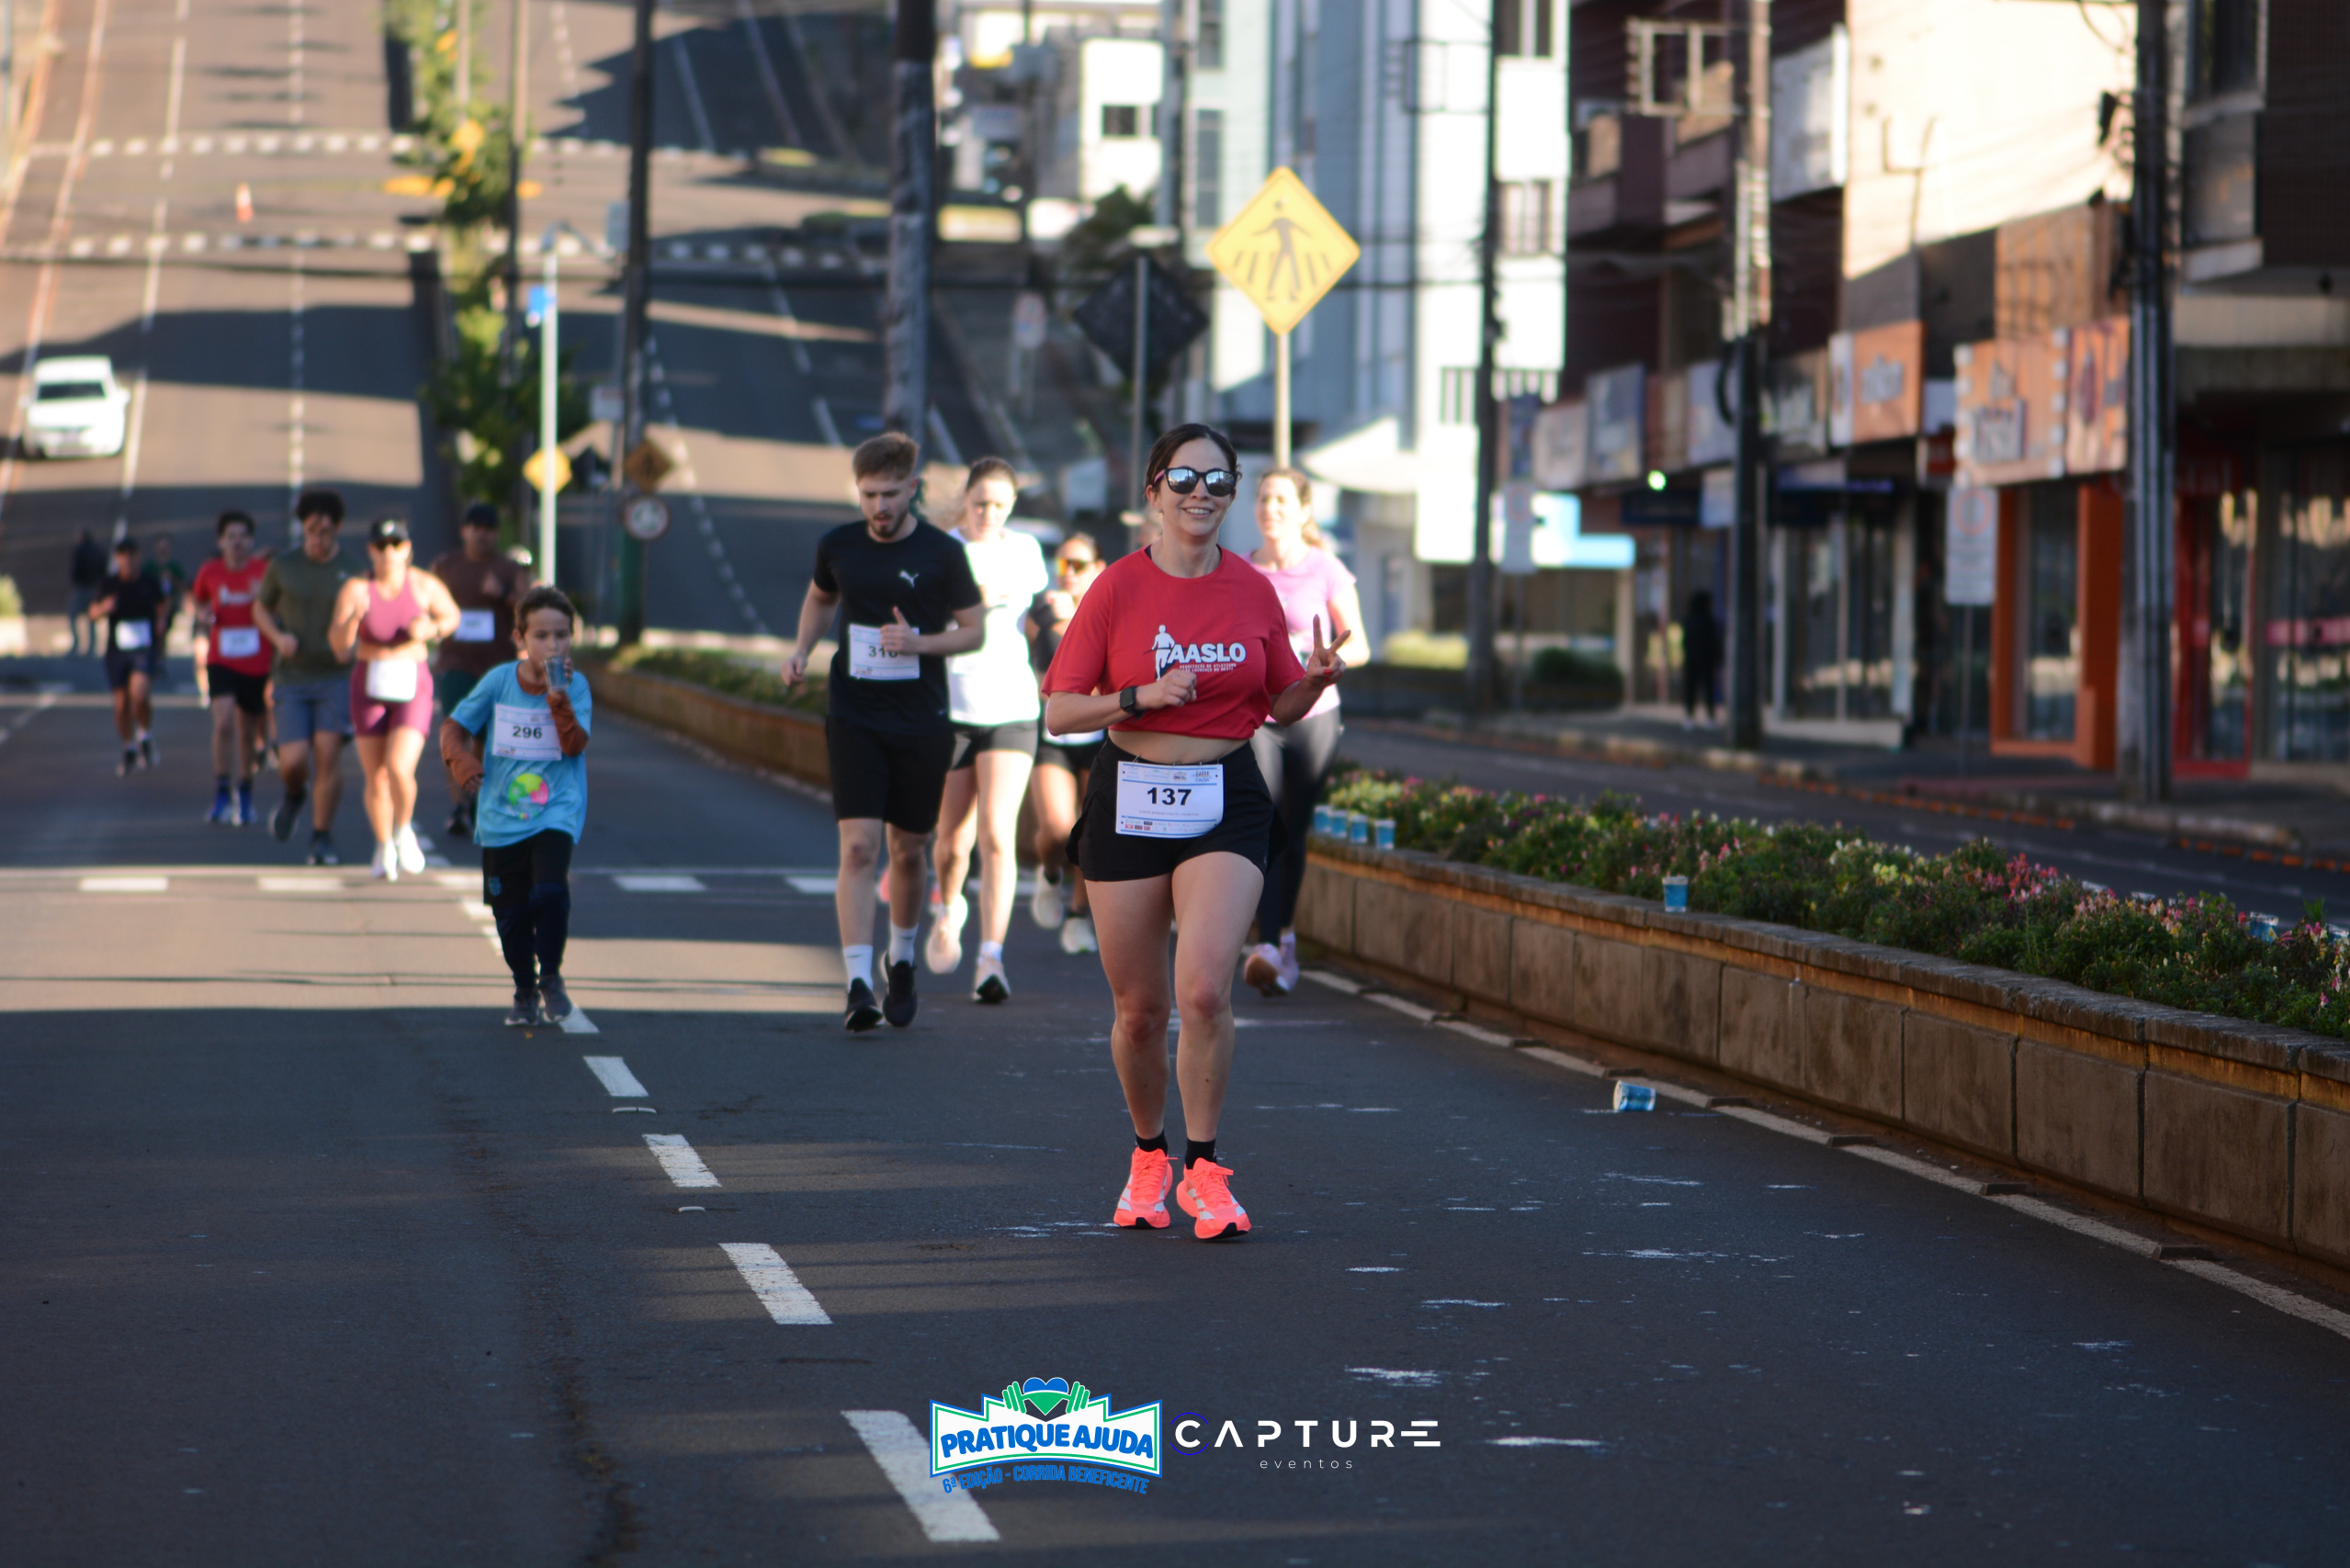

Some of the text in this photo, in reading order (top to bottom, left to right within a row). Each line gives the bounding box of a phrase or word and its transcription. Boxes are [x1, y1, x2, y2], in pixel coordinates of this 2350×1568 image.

[1167, 643, 1246, 663] AASLO
[513, 726, 542, 739] 296
[1147, 786, 1192, 807] 137
